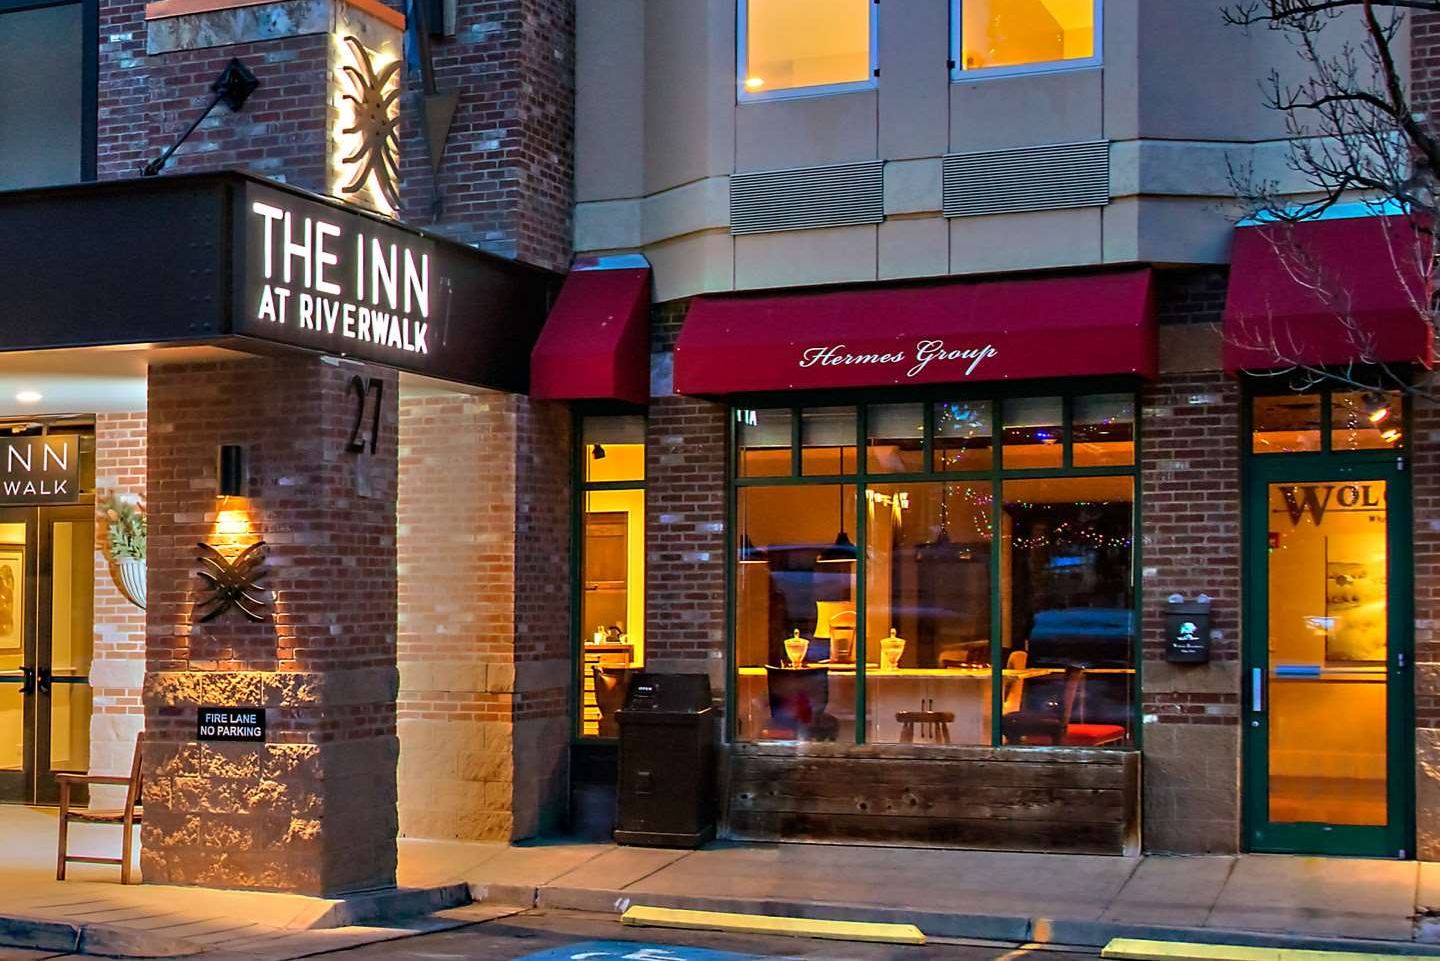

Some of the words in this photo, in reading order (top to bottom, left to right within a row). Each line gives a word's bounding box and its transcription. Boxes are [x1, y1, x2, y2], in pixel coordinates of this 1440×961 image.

[252, 201, 341, 296] THE
[356, 232, 429, 319] INN
[257, 284, 291, 325] AT
[299, 292, 429, 355] RIVERWALK
[799, 344, 905, 368] Hermes
[906, 339, 998, 377] Group
[344, 374, 384, 456] 27
[1278, 485, 1386, 527] WOL
[200, 725, 215, 736] NO
[217, 726, 262, 737] PARKING
[205, 713, 228, 724] FIRE
[229, 713, 257, 724] LANE
